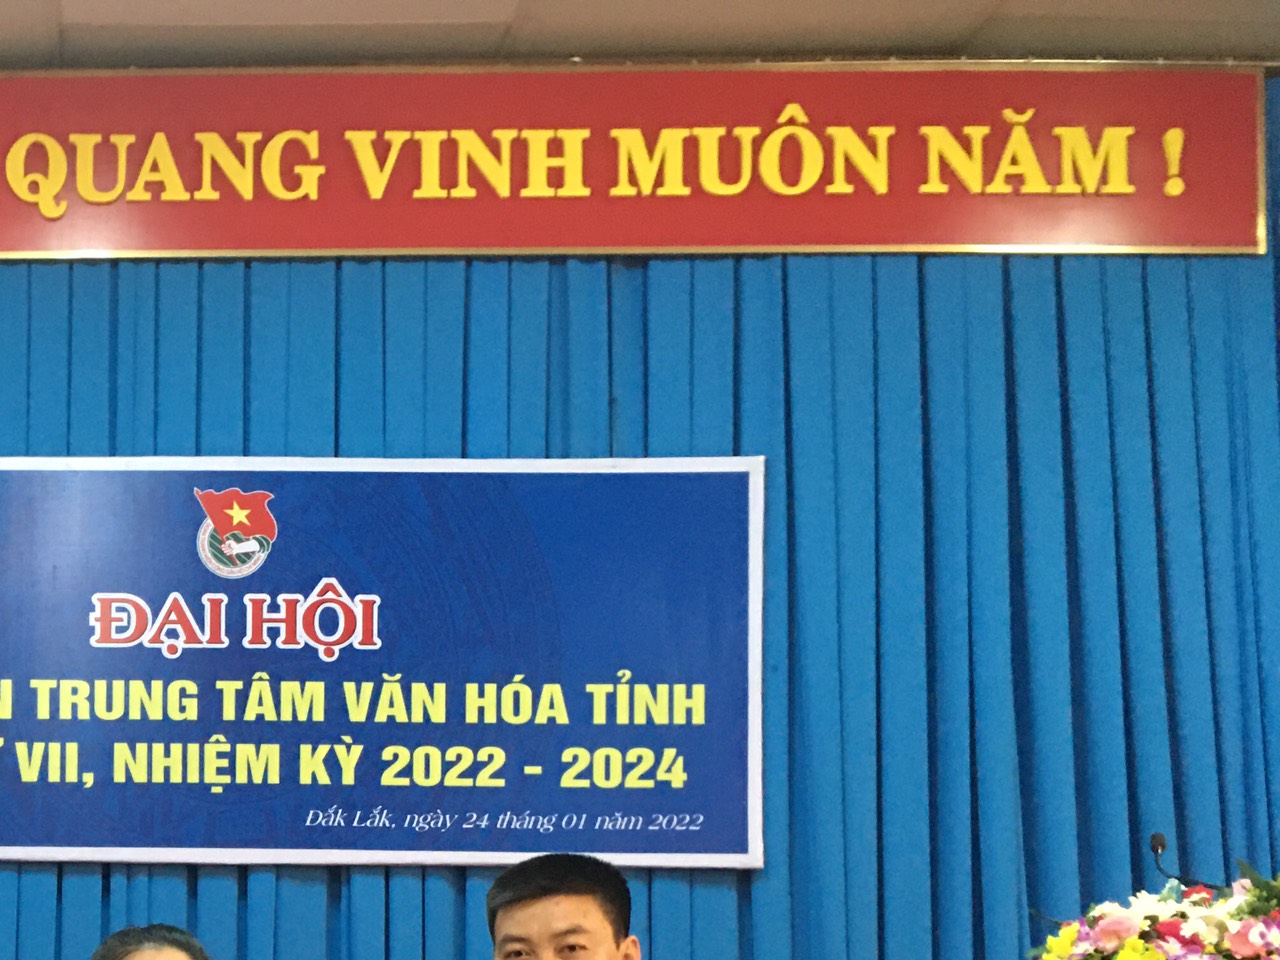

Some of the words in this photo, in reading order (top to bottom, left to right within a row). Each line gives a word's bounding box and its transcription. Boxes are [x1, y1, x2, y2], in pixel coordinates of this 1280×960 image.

[5, 129, 325, 219] QUANG
[344, 128, 591, 200] VINH
[609, 102, 897, 197] MUÔN
[918, 107, 1136, 196] NĂM
[1161, 126, 1186, 197] !
[90, 592, 229, 659] ĐẠI
[242, 578, 381, 662] HỘI
[30, 679, 198, 721] TRUNG
[215, 672, 325, 722] TÂM
[343, 673, 447, 724] VĂN
[465, 674, 569, 725] HÓA
[585, 669, 706, 725] TỈNH
[15, 741, 94, 788] VII,
[113, 734, 280, 794] NHIỆM
[299, 735, 363, 786] KỲ
[380, 745, 506, 787] 2022
[523, 765, 543, 776] -
[559, 747, 688, 789] 2024
[305, 804, 347, 827] Đắk
[352, 805, 396, 829] Lắk,
[403, 809, 458, 832] ngày
[462, 812, 489, 829] 24
[496, 810, 558, 833] tháng
[561, 813, 587, 830] 01
[594, 812, 643, 831] năm
[648, 813, 704, 831] 2022
